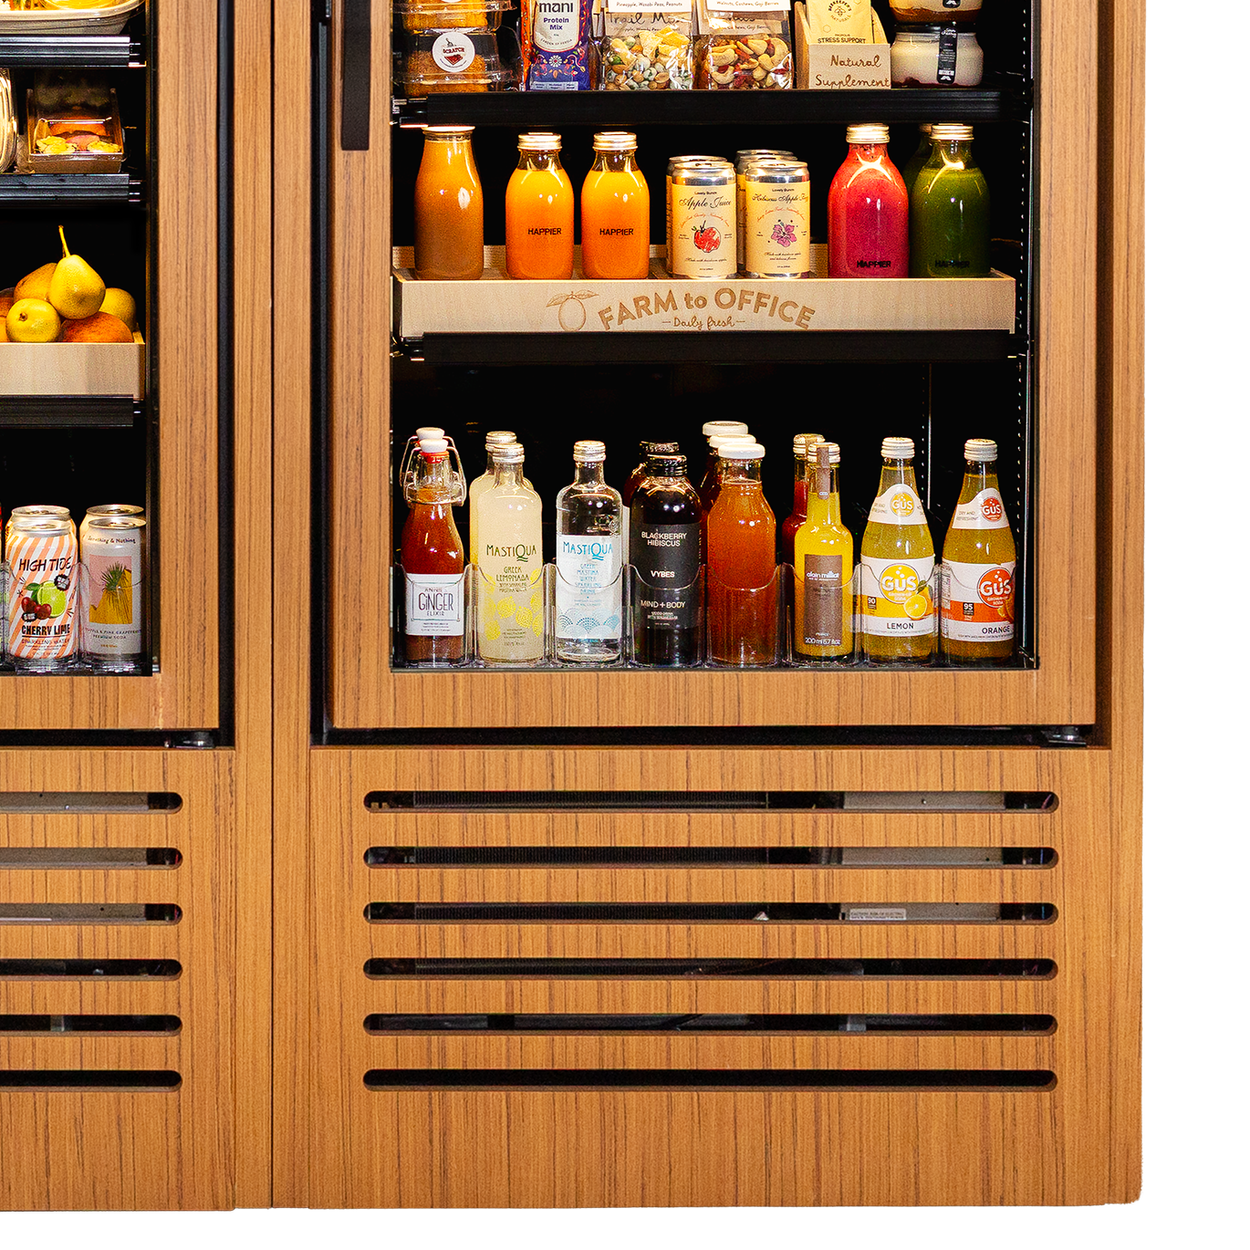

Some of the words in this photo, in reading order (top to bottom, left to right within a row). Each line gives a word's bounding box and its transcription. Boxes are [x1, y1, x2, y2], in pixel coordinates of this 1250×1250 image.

[539, 2, 574, 13] mani
[830, 54, 882, 68] Natural
[816, 74, 891, 89] Supplement
[678, 196, 708, 210] Apple
[528, 228, 562, 236] HAPPIER
[599, 228, 634, 236] HAPPIER
[856, 260, 891, 268] HAPPIER
[935, 260, 970, 268] HAPPIER
[597, 289, 678, 330] FARM
[683, 292, 708, 310] to
[714, 287, 816, 330] OFFICE
[673, 316, 704, 330] Daily
[706, 316, 736, 330] fresh
[641, 531, 687, 540] BLACKBERRY
[18, 558, 47, 572] HIGH
[49, 556, 72, 571] TIDE
[504, 566, 522, 574] GREEK
[650, 570, 676, 578] VYBES
[641, 600, 659, 608] MIND
[22, 624, 52, 636] CHERRY
[54, 624, 70, 635] LIME
[886, 622, 914, 630] LEMON
[982, 626, 1010, 634] ORANGE
